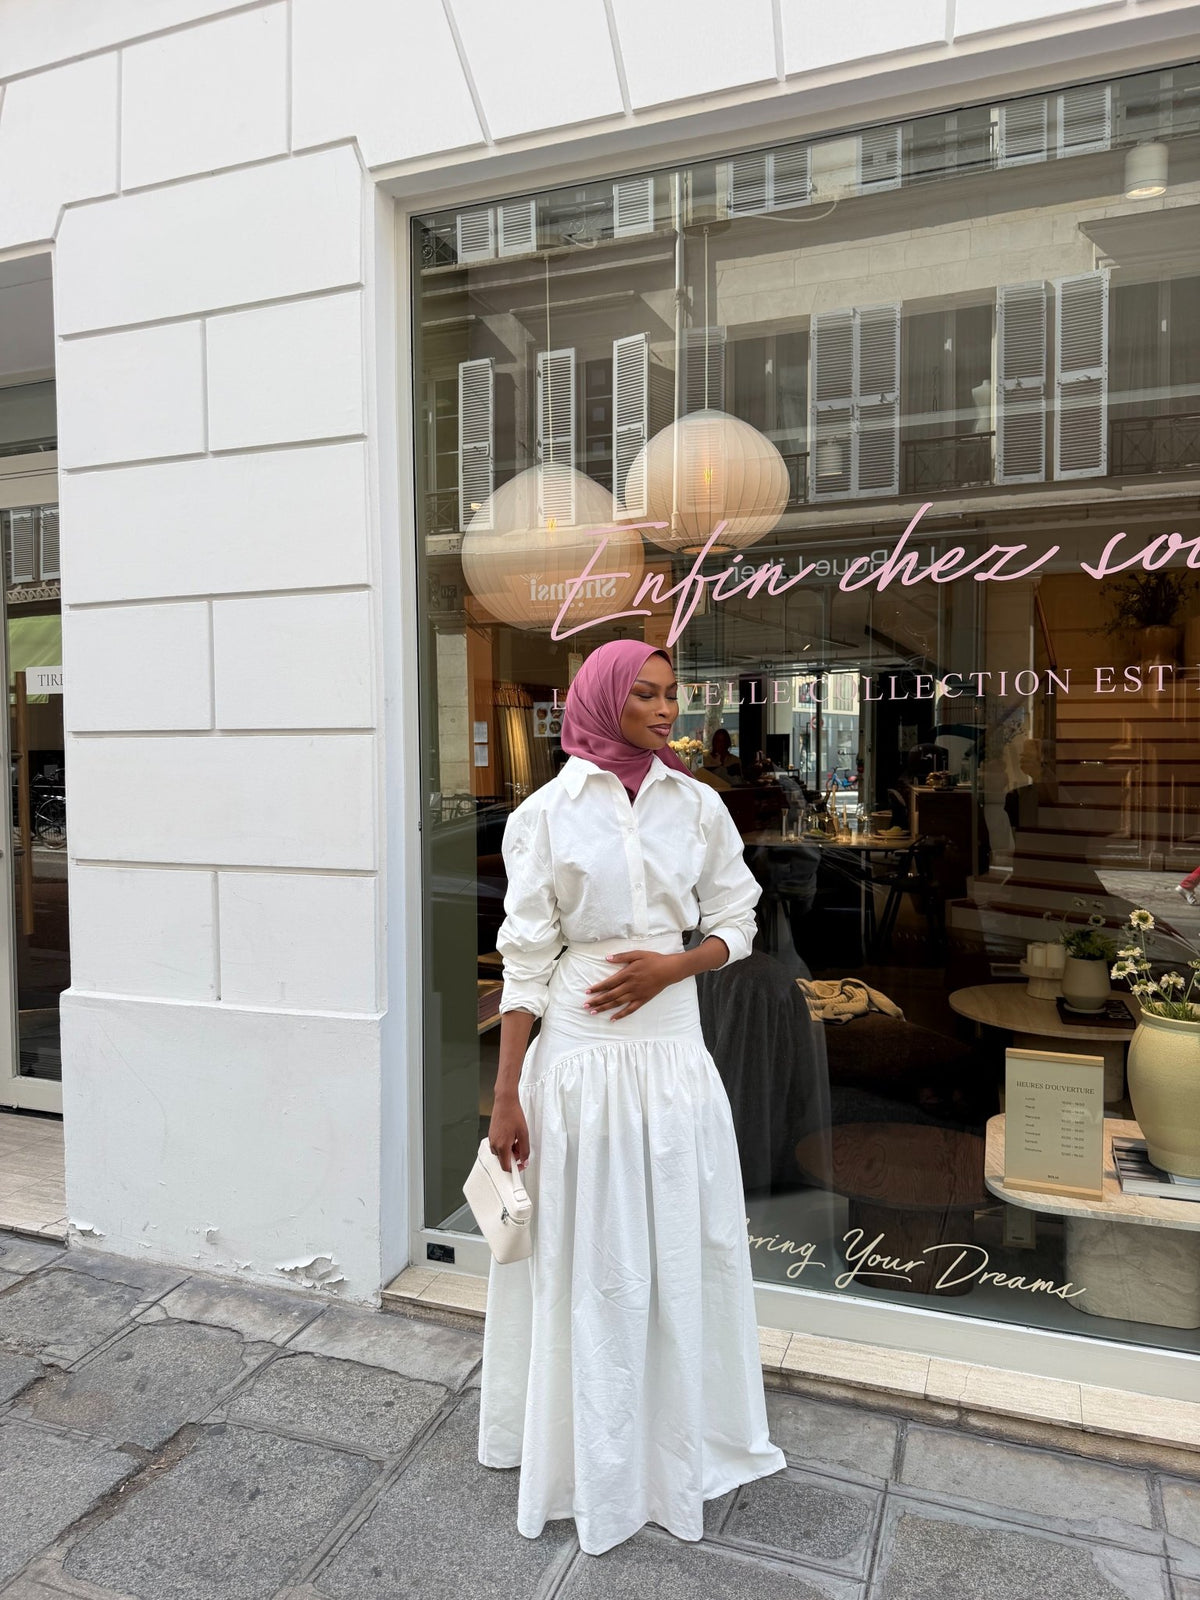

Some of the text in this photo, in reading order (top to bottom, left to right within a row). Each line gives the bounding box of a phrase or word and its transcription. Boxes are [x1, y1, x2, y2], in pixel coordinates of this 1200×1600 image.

[550, 520, 816, 648] Enfin
[839, 502, 1060, 592] chez
[810, 669, 1072, 702] COLLECTION
[1094, 665, 1173, 693] EST
[834, 1228, 925, 1289] Your
[922, 1243, 1087, 1299] Dreams
